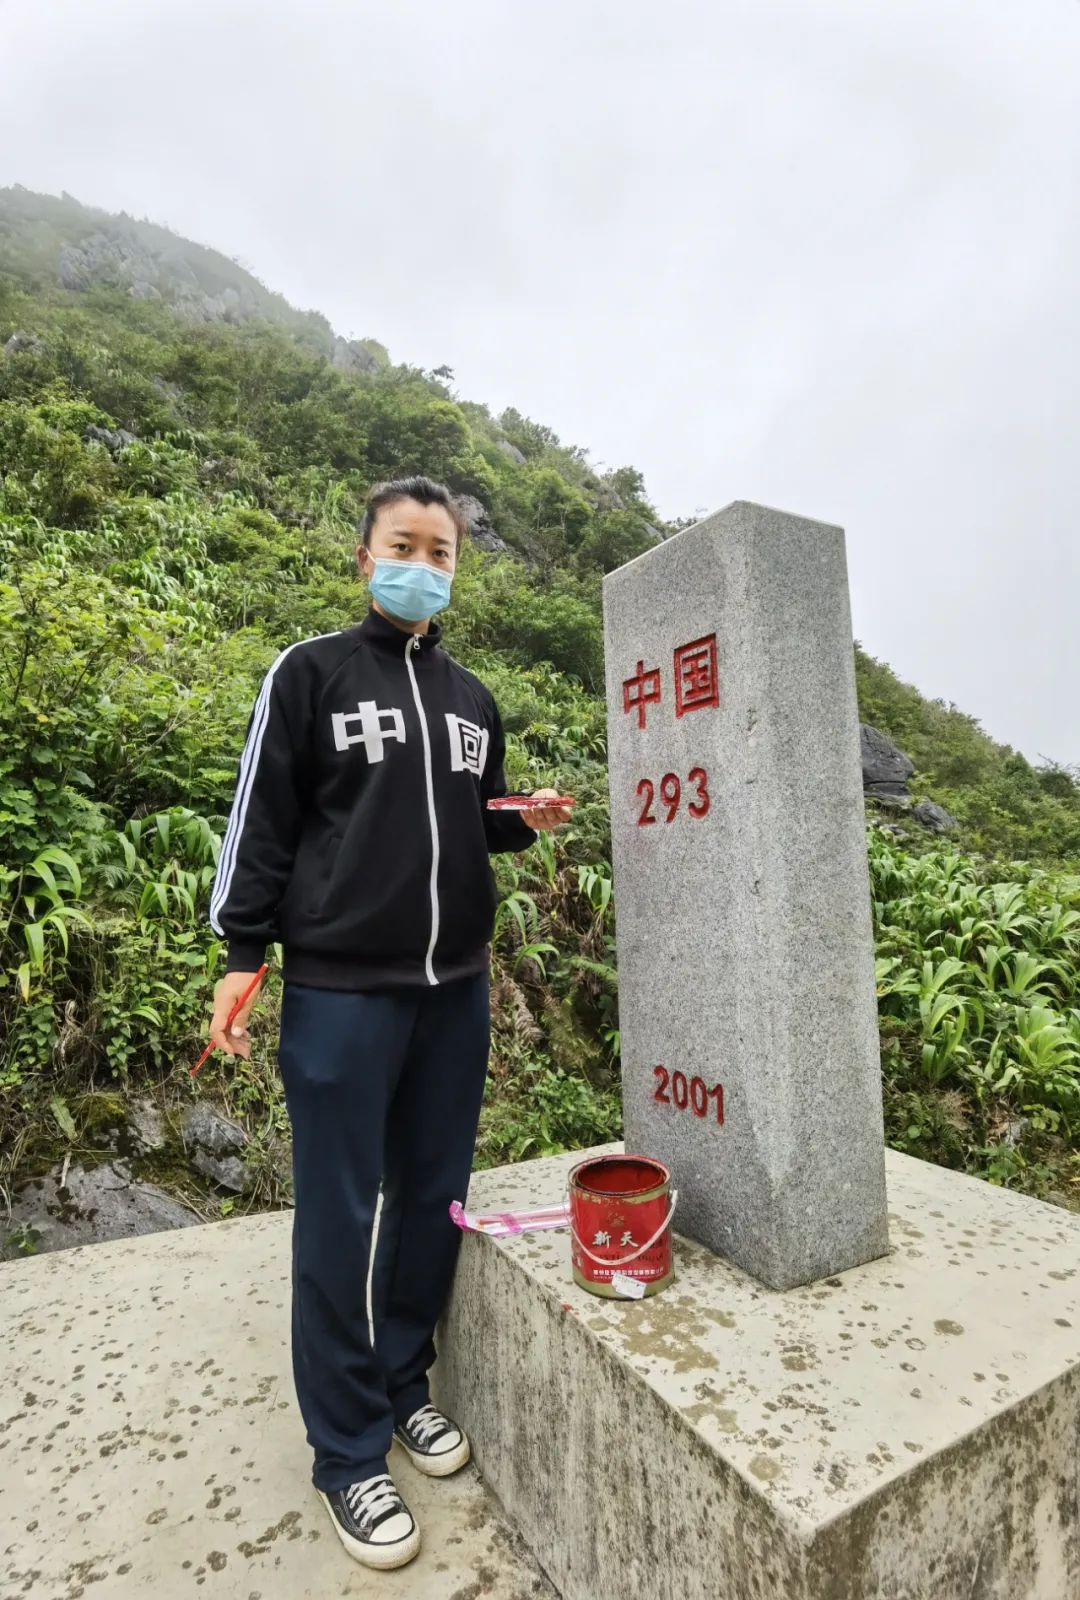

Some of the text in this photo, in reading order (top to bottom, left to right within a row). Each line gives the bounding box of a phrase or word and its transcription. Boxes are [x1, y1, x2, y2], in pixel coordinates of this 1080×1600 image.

[622, 632, 719, 729] 中国
[636, 767, 710, 826] 293
[653, 1065, 724, 1127] 2001
